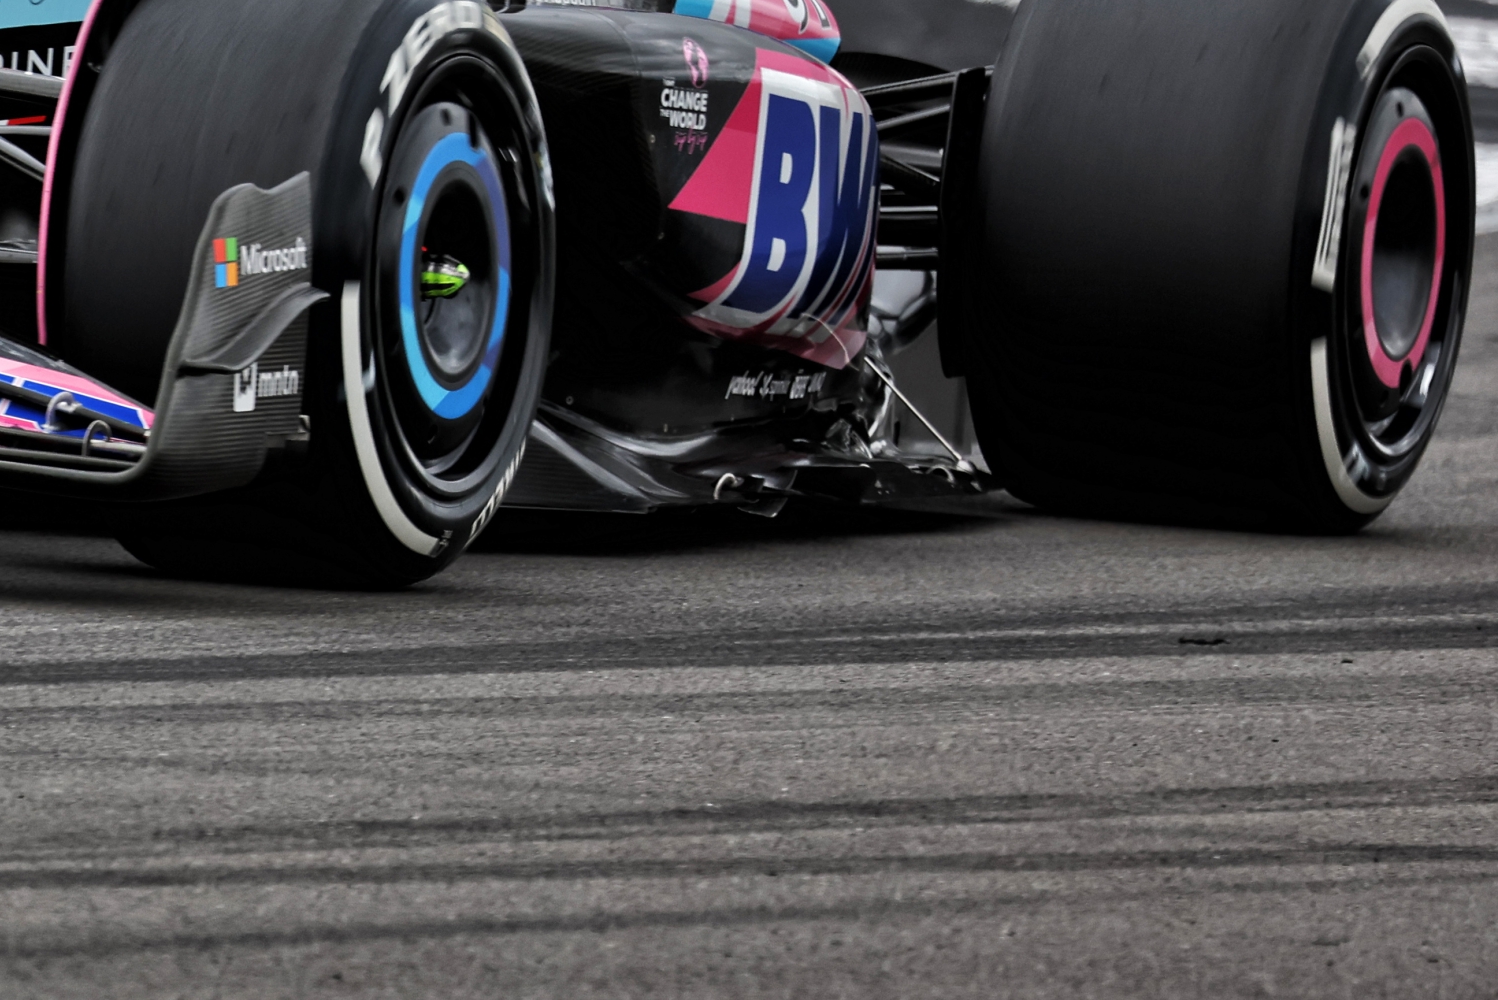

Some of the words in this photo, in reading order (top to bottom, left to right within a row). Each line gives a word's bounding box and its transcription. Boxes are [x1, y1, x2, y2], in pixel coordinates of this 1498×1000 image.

[660, 88, 709, 112] CHANGE
[669, 110, 707, 131] WORLD
[240, 237, 308, 276] Microsoft
